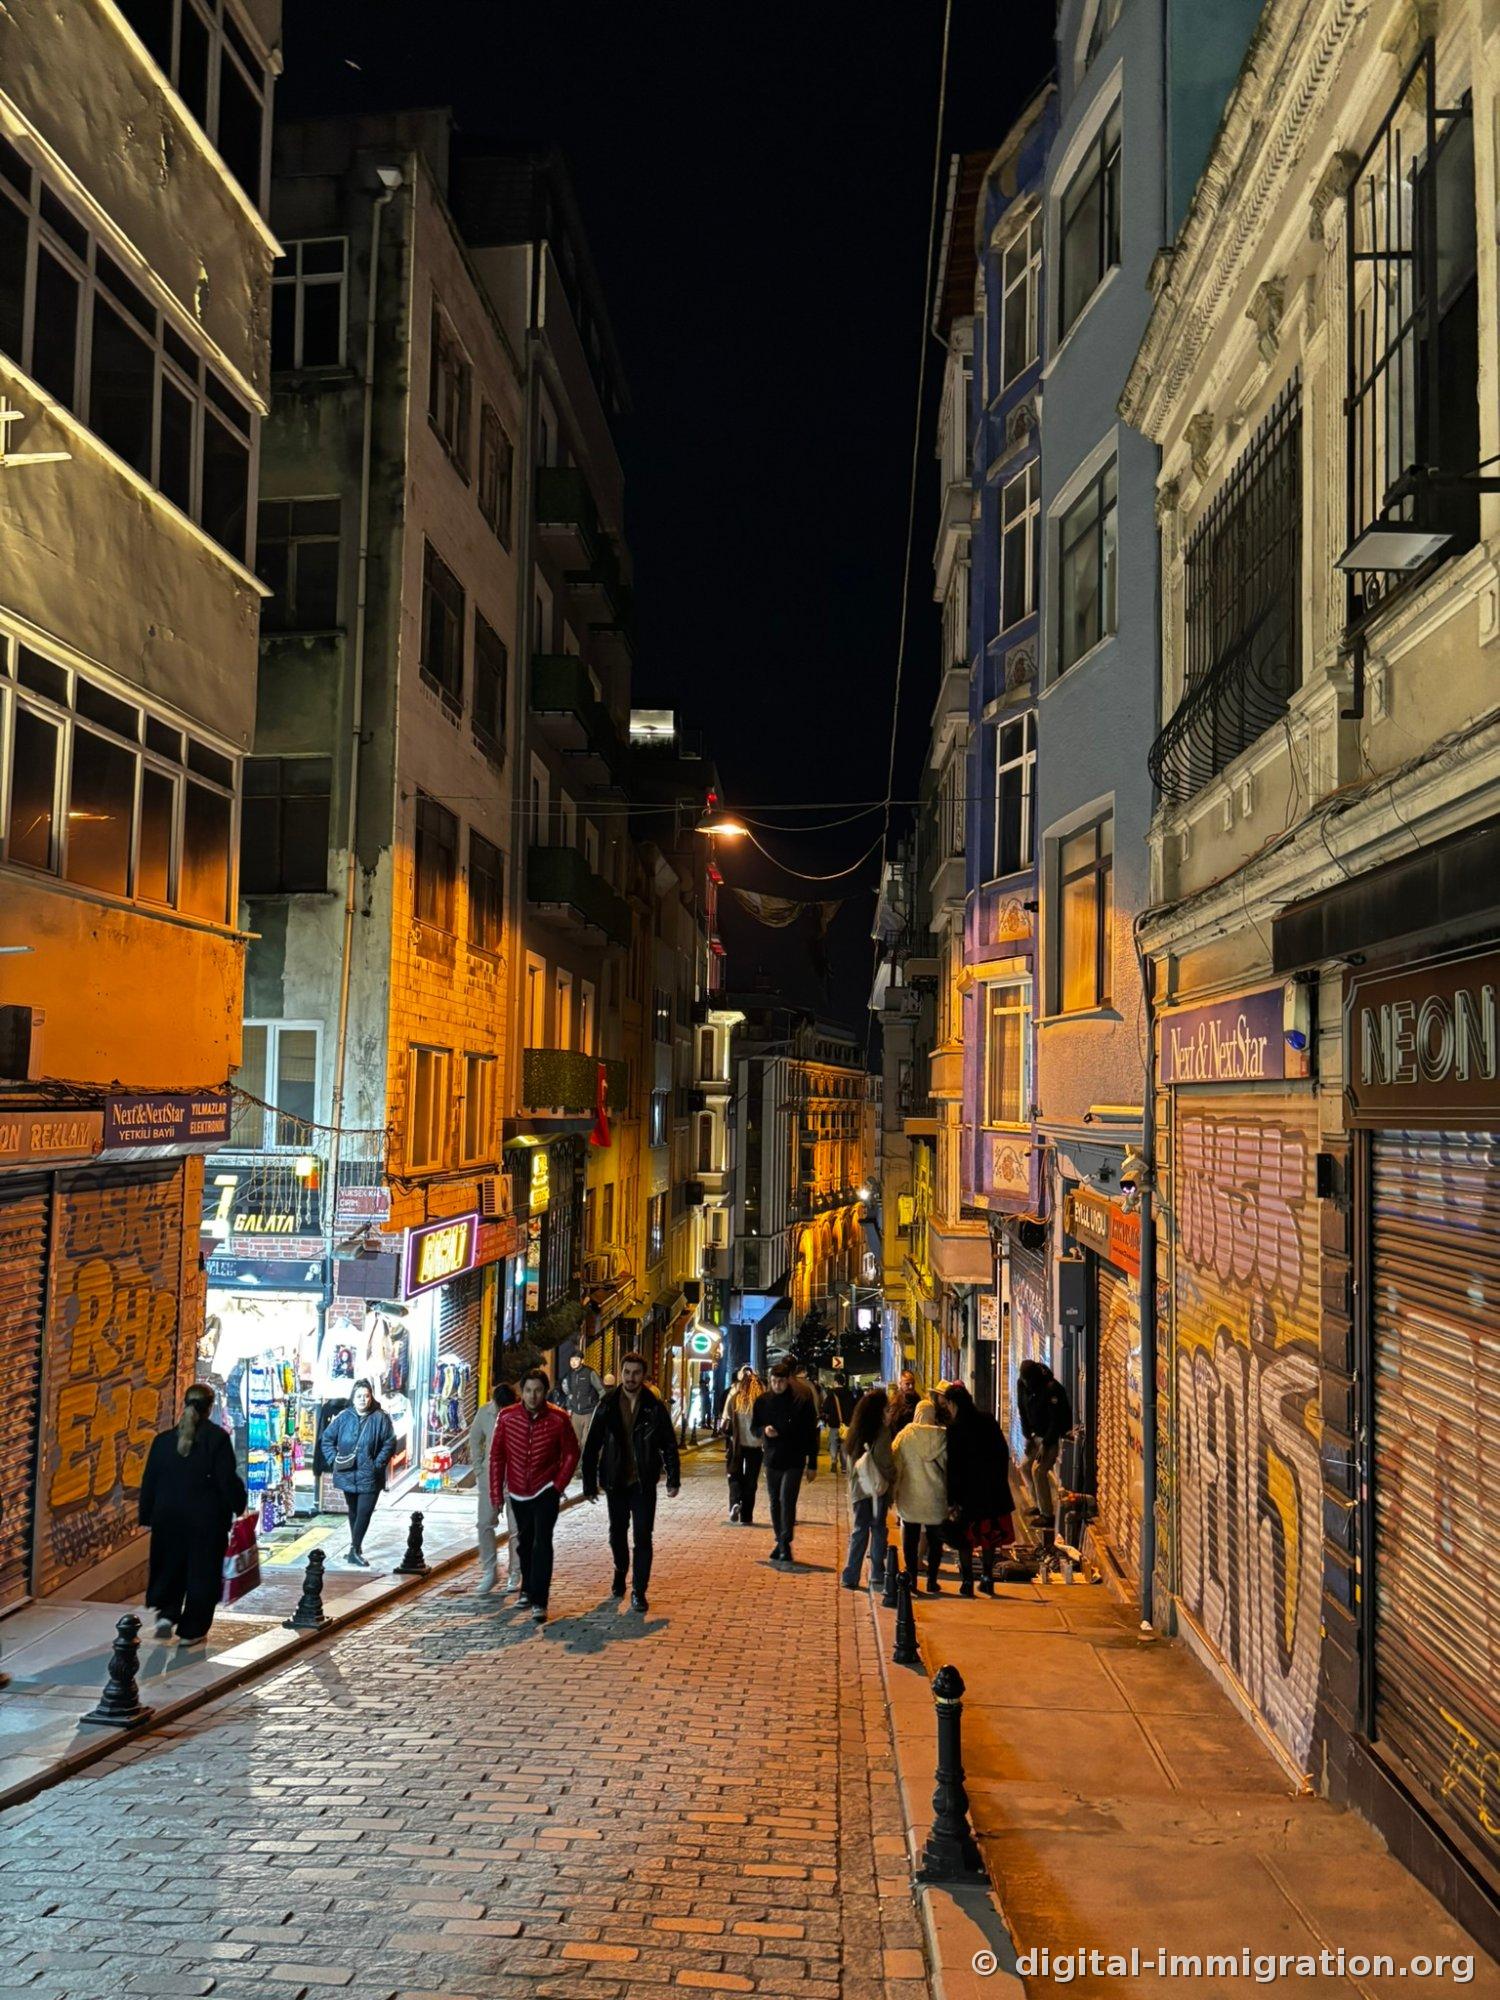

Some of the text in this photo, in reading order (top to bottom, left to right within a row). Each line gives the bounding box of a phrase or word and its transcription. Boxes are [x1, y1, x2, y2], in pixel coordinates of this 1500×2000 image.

[1361, 984, 1496, 1085] NEON
[191, 1102, 227, 1116] YILMAZLAR
[30, 1122, 91, 1150] REKLAM
[119, 1126, 151, 1141] YETKİLİ
[233, 1213, 295, 1233] GALATA
